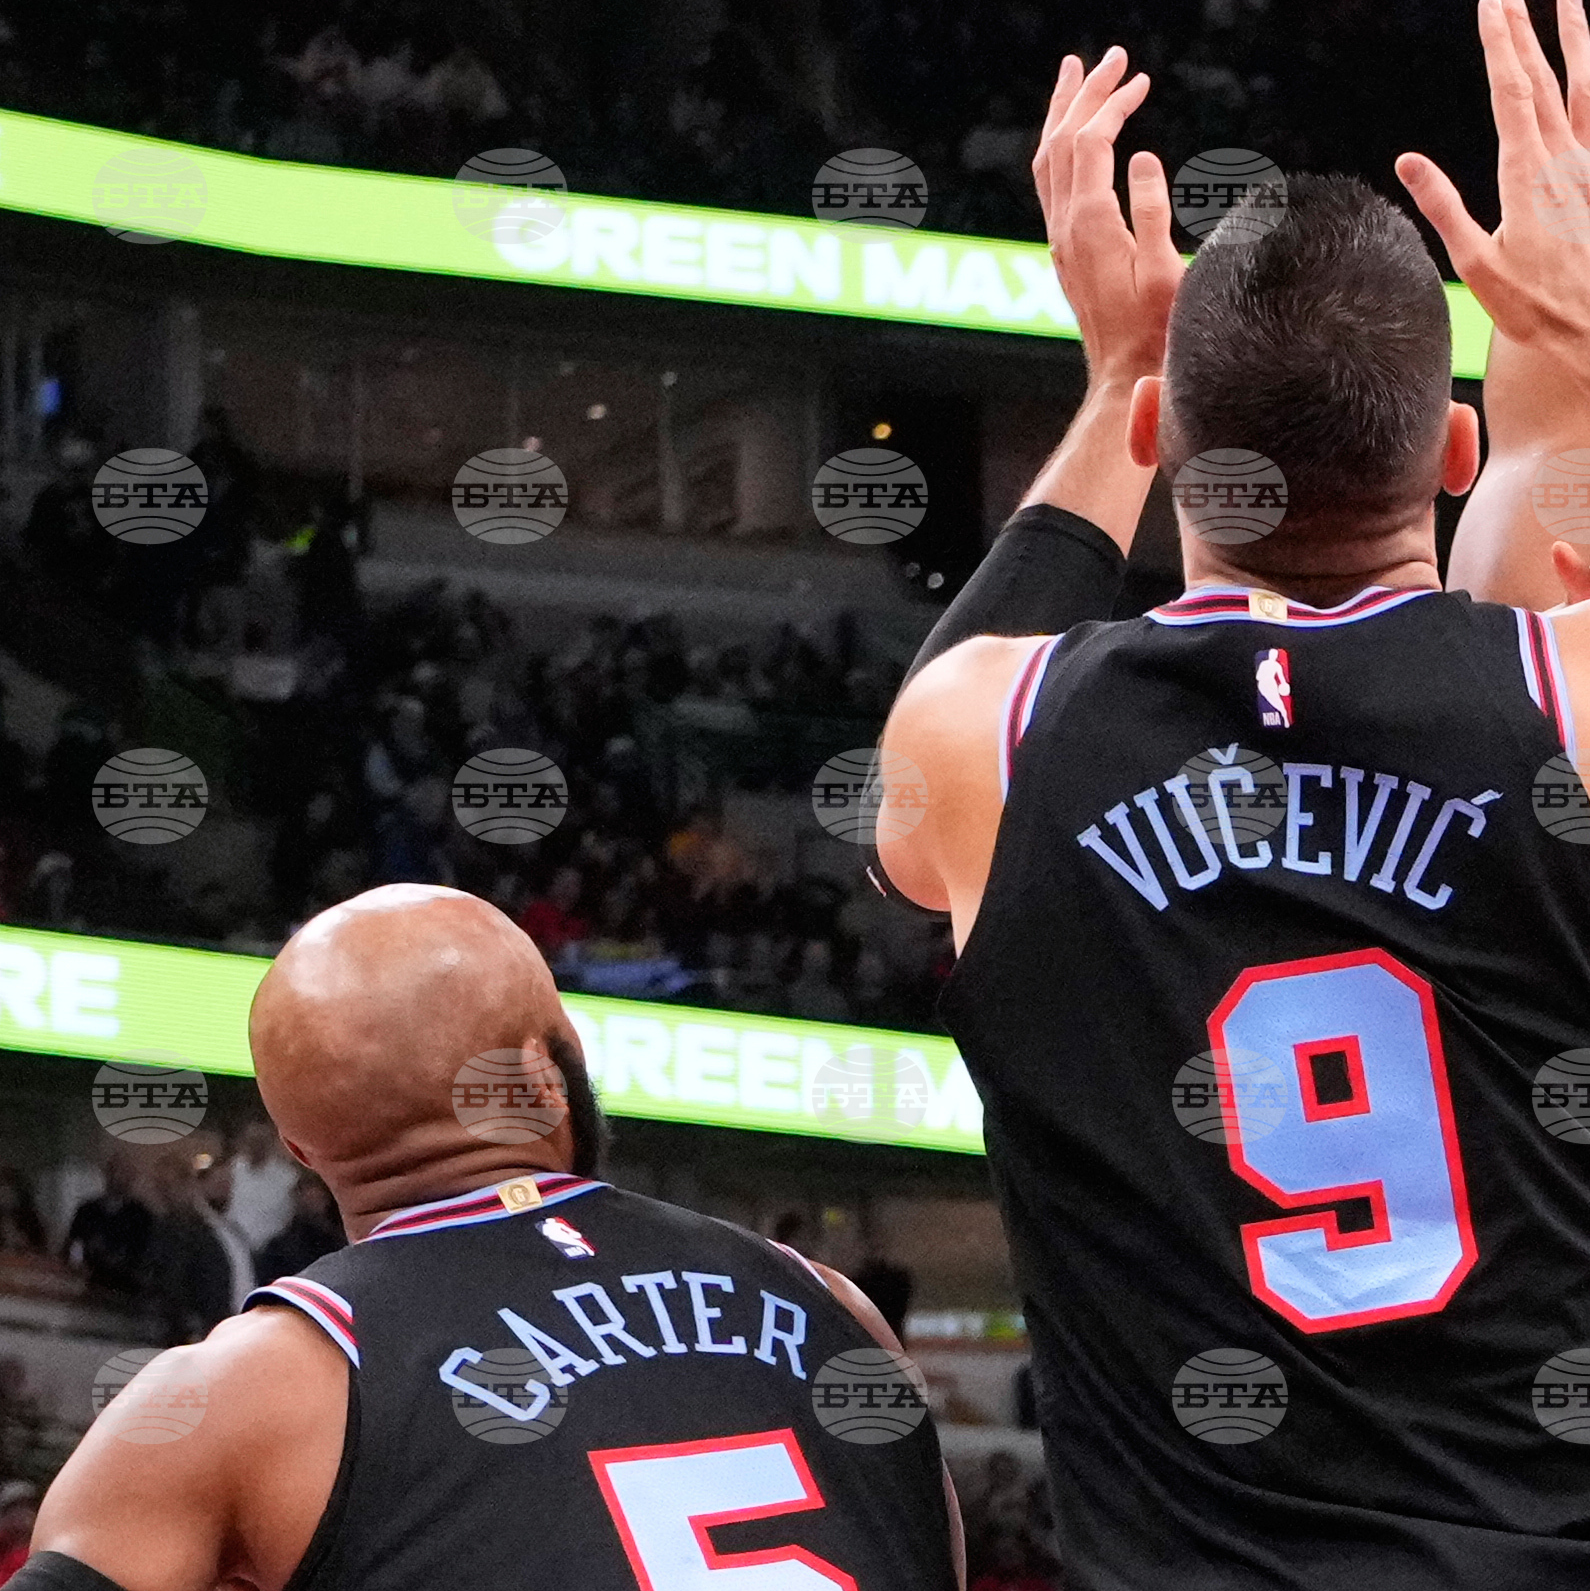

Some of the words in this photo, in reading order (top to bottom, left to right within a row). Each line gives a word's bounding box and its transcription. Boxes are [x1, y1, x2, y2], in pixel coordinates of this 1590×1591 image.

[493, 197, 843, 302] GREEN
[862, 239, 1078, 325] MAX
[1262, 711, 1282, 727] NBA
[1076, 742, 1503, 911] VUČEVIĆ
[0, 942, 121, 1038] RE
[1206, 947, 1479, 1334] 9
[438, 1270, 808, 1421] CARTER
